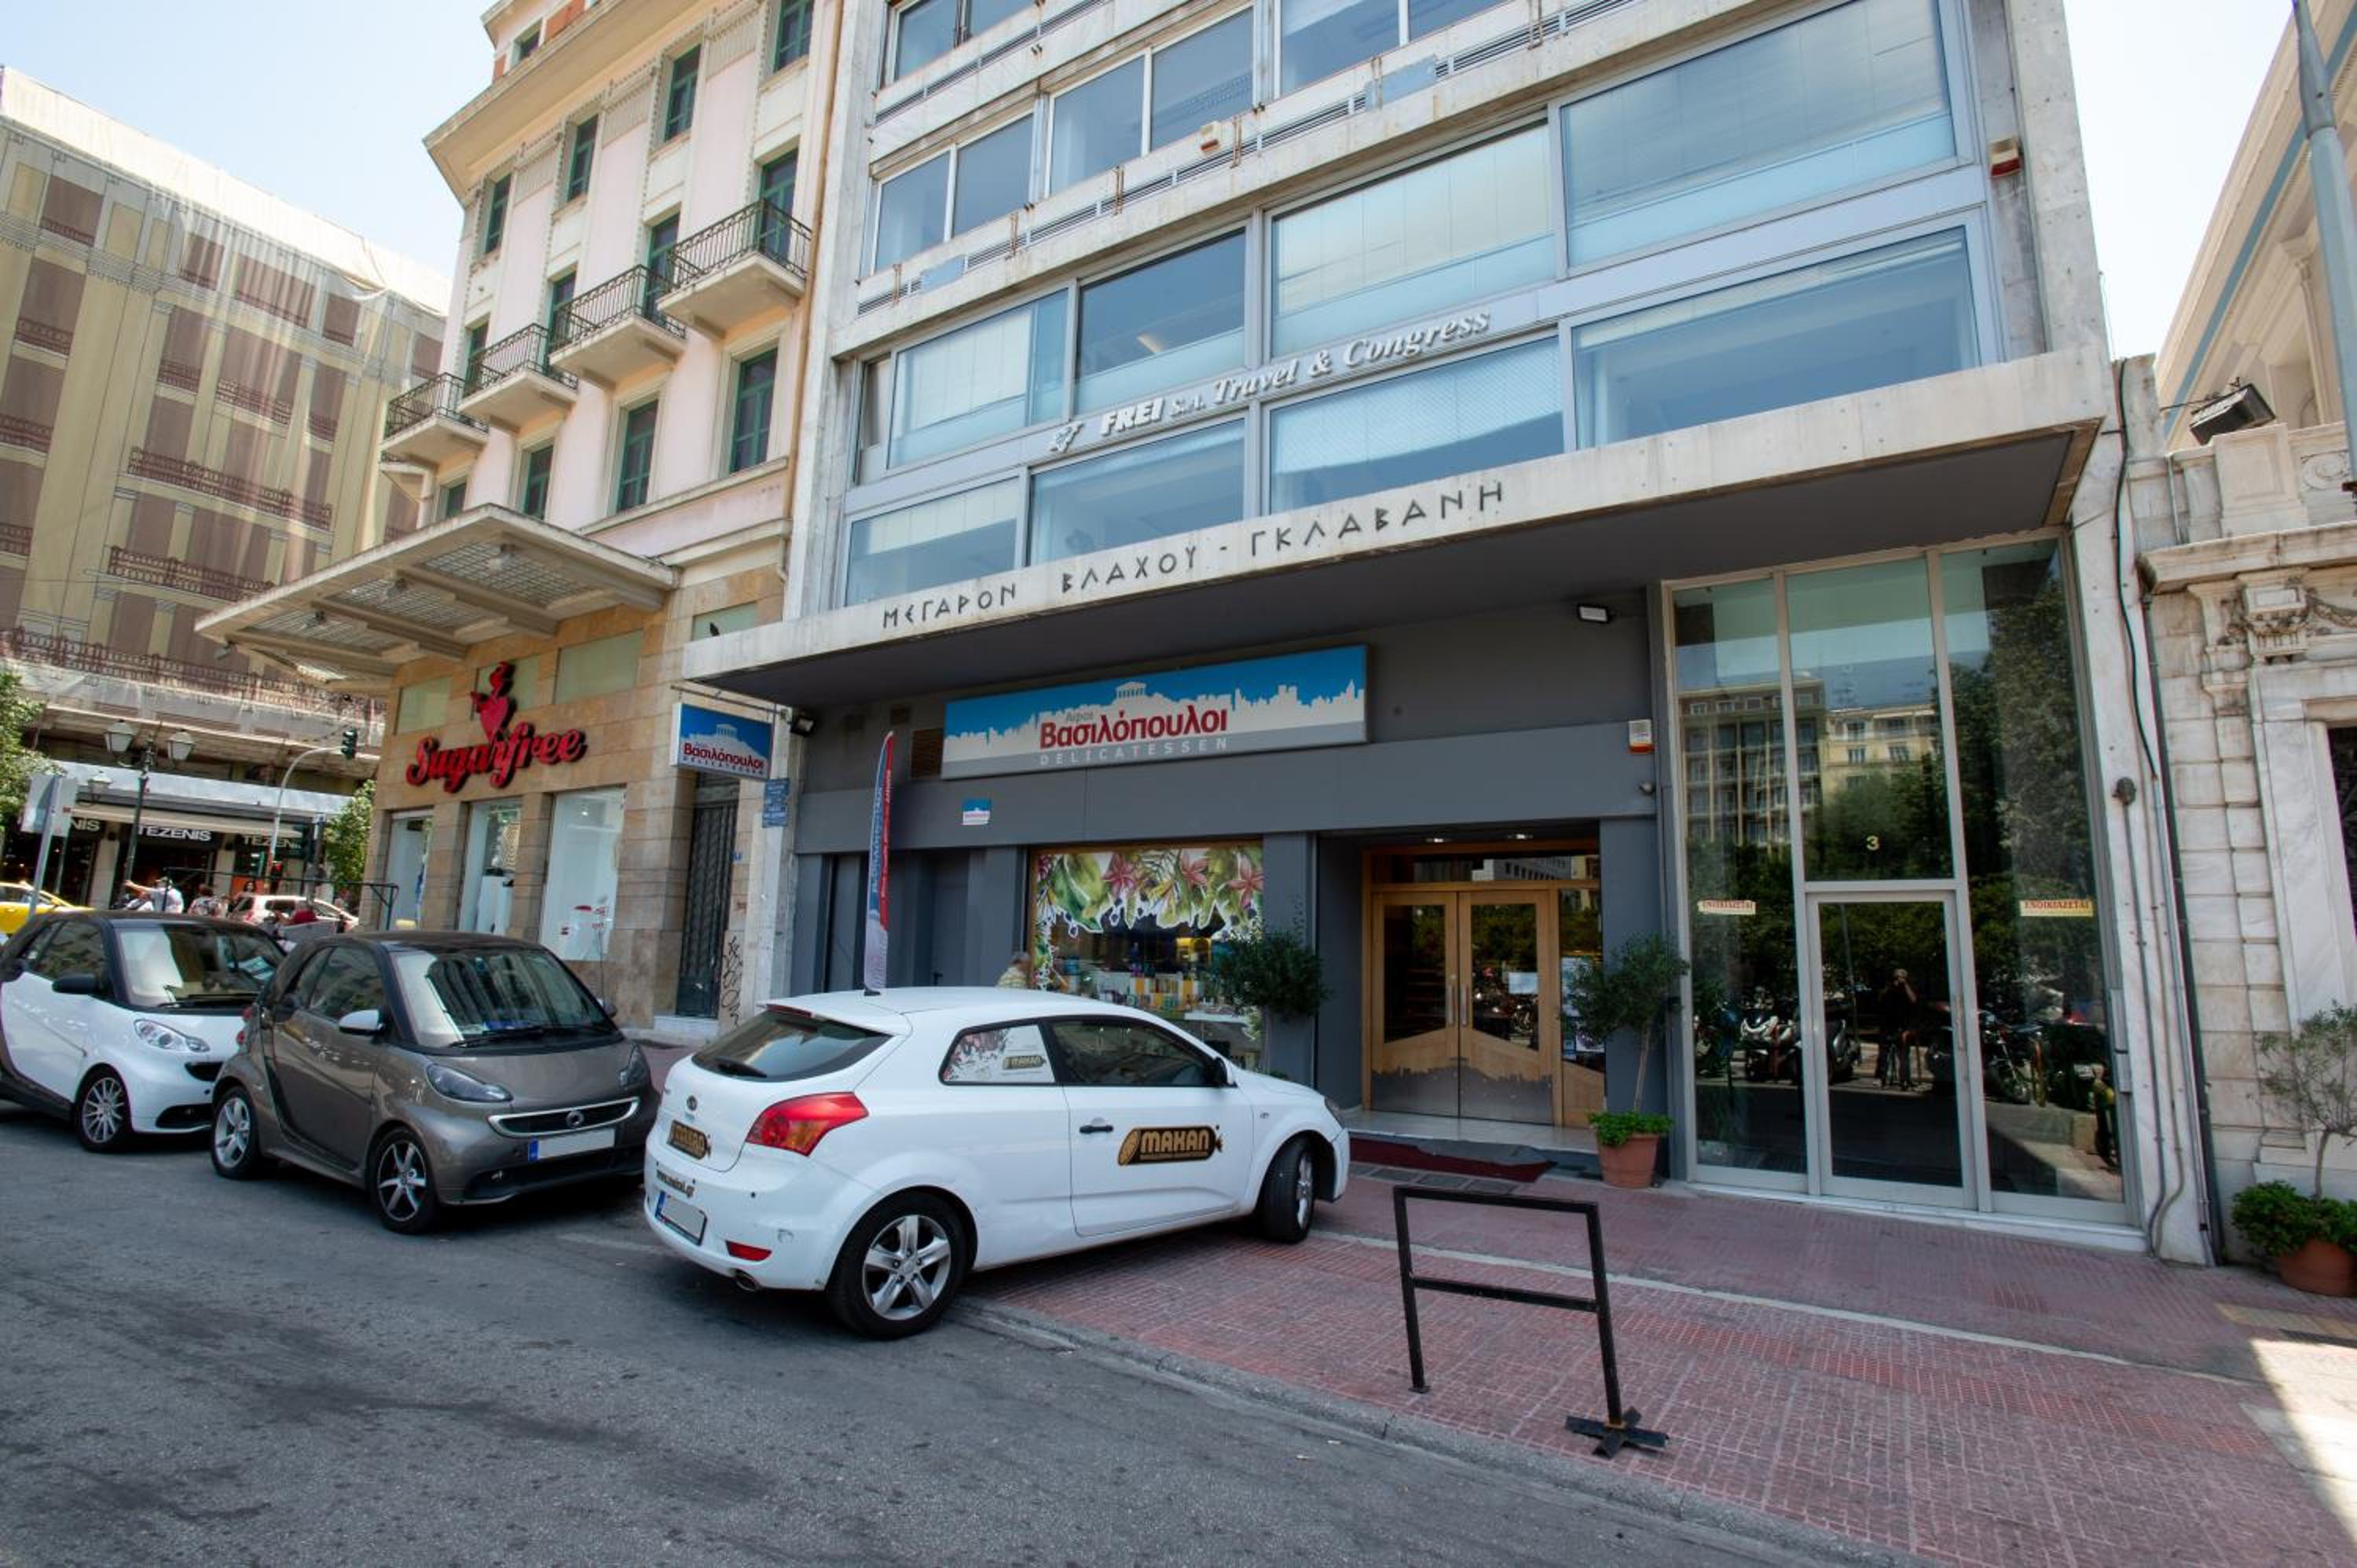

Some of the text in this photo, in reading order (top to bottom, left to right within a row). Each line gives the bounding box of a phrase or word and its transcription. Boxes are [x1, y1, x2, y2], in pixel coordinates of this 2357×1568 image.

[1101, 397, 1165, 437] FREI
[1215, 358, 1299, 405] Travel
[1308, 349, 1332, 378] &
[1343, 312, 1490, 368] Congress
[882, 583, 1017, 628] ΜΕΓΑΡΟΝ
[1061, 546, 1197, 594] ΒΛΑΧΟΥ
[1251, 481, 1503, 557] ΓΚΛΑΒΑΝΗ
[1039, 705, 1228, 749] Βασιλόπουλοι
[1039, 738, 1227, 766] DELICATESSEN
[137, 824, 211, 841] TEZENIS
[1866, 835, 1879, 851] 3
[1139, 1130, 1209, 1153] MAKAN
